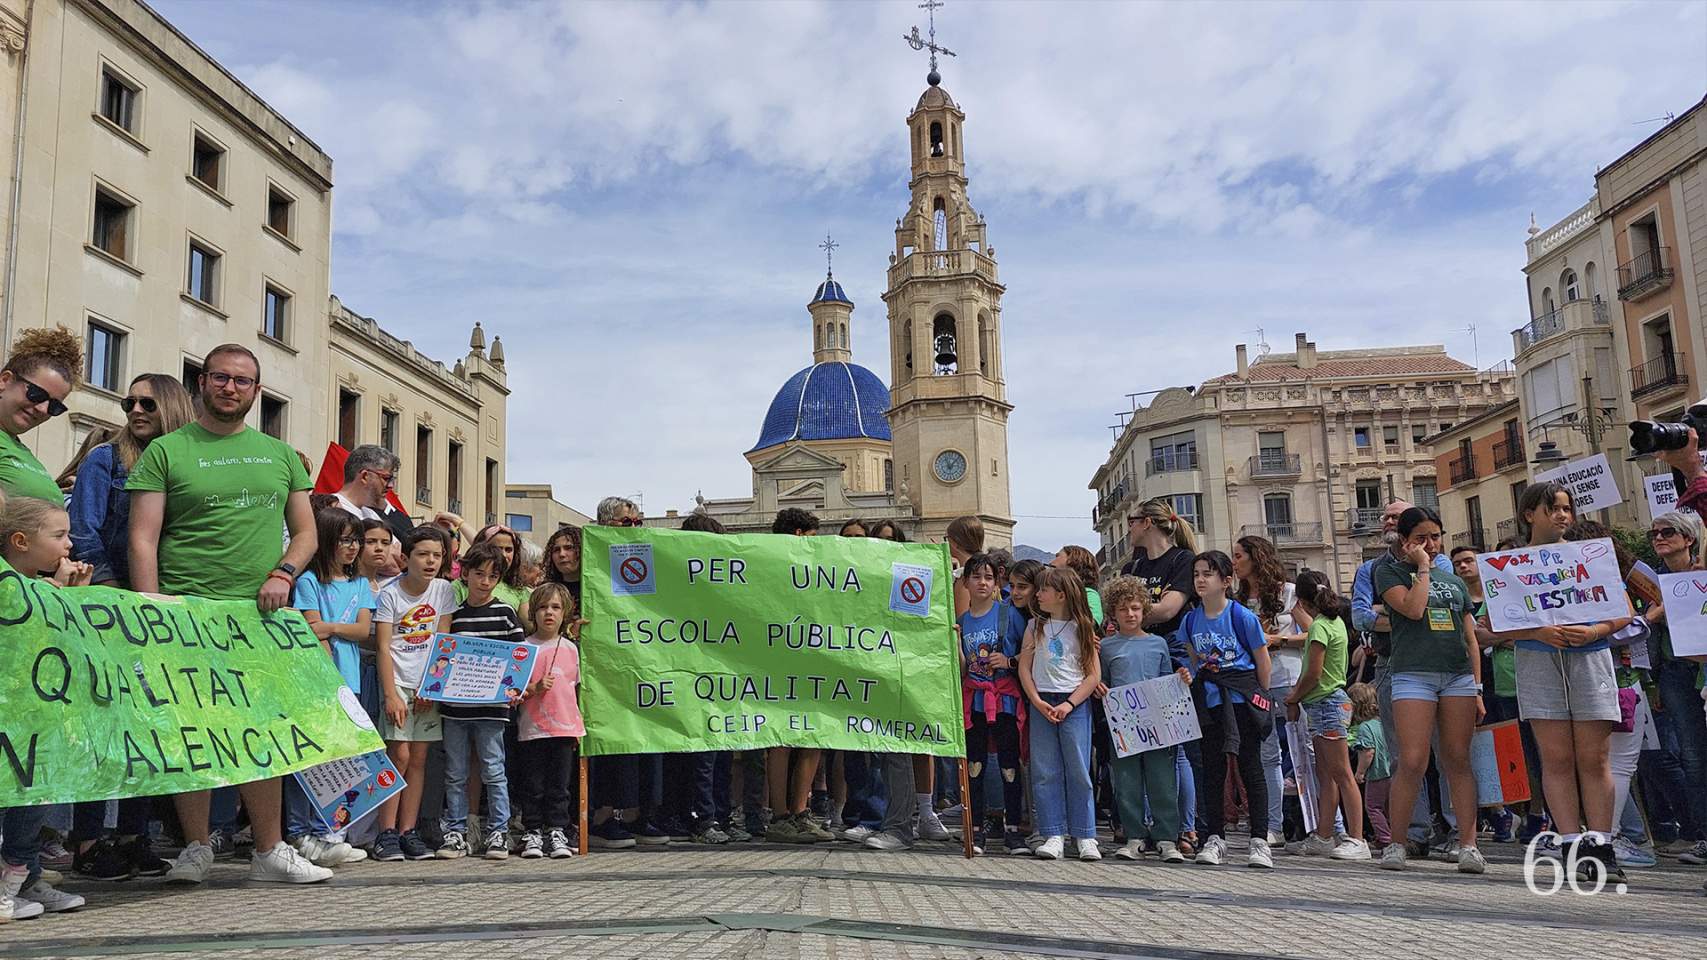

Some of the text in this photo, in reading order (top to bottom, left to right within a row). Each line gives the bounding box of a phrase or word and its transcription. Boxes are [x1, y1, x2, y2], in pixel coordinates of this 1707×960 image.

[1567, 463, 1604, 484] EDUCACIÓ
[1576, 478, 1601, 494] SENSE
[1574, 494, 1595, 508] ORES
[687, 557, 748, 585] PER
[790, 565, 863, 593] UNA
[1485, 578, 1507, 598] EL
[261, 616, 319, 651] DE
[616, 616, 897, 655] ESCOLA PÚBLICA
[31, 646, 251, 710] QUALITAT
[636, 673, 879, 708] DE QUALITAT
[707, 713, 948, 744] CEIP EL ROMERAL
[82, 714, 325, 779] VALENCIÀ
[379, 771, 394, 785] STOP
